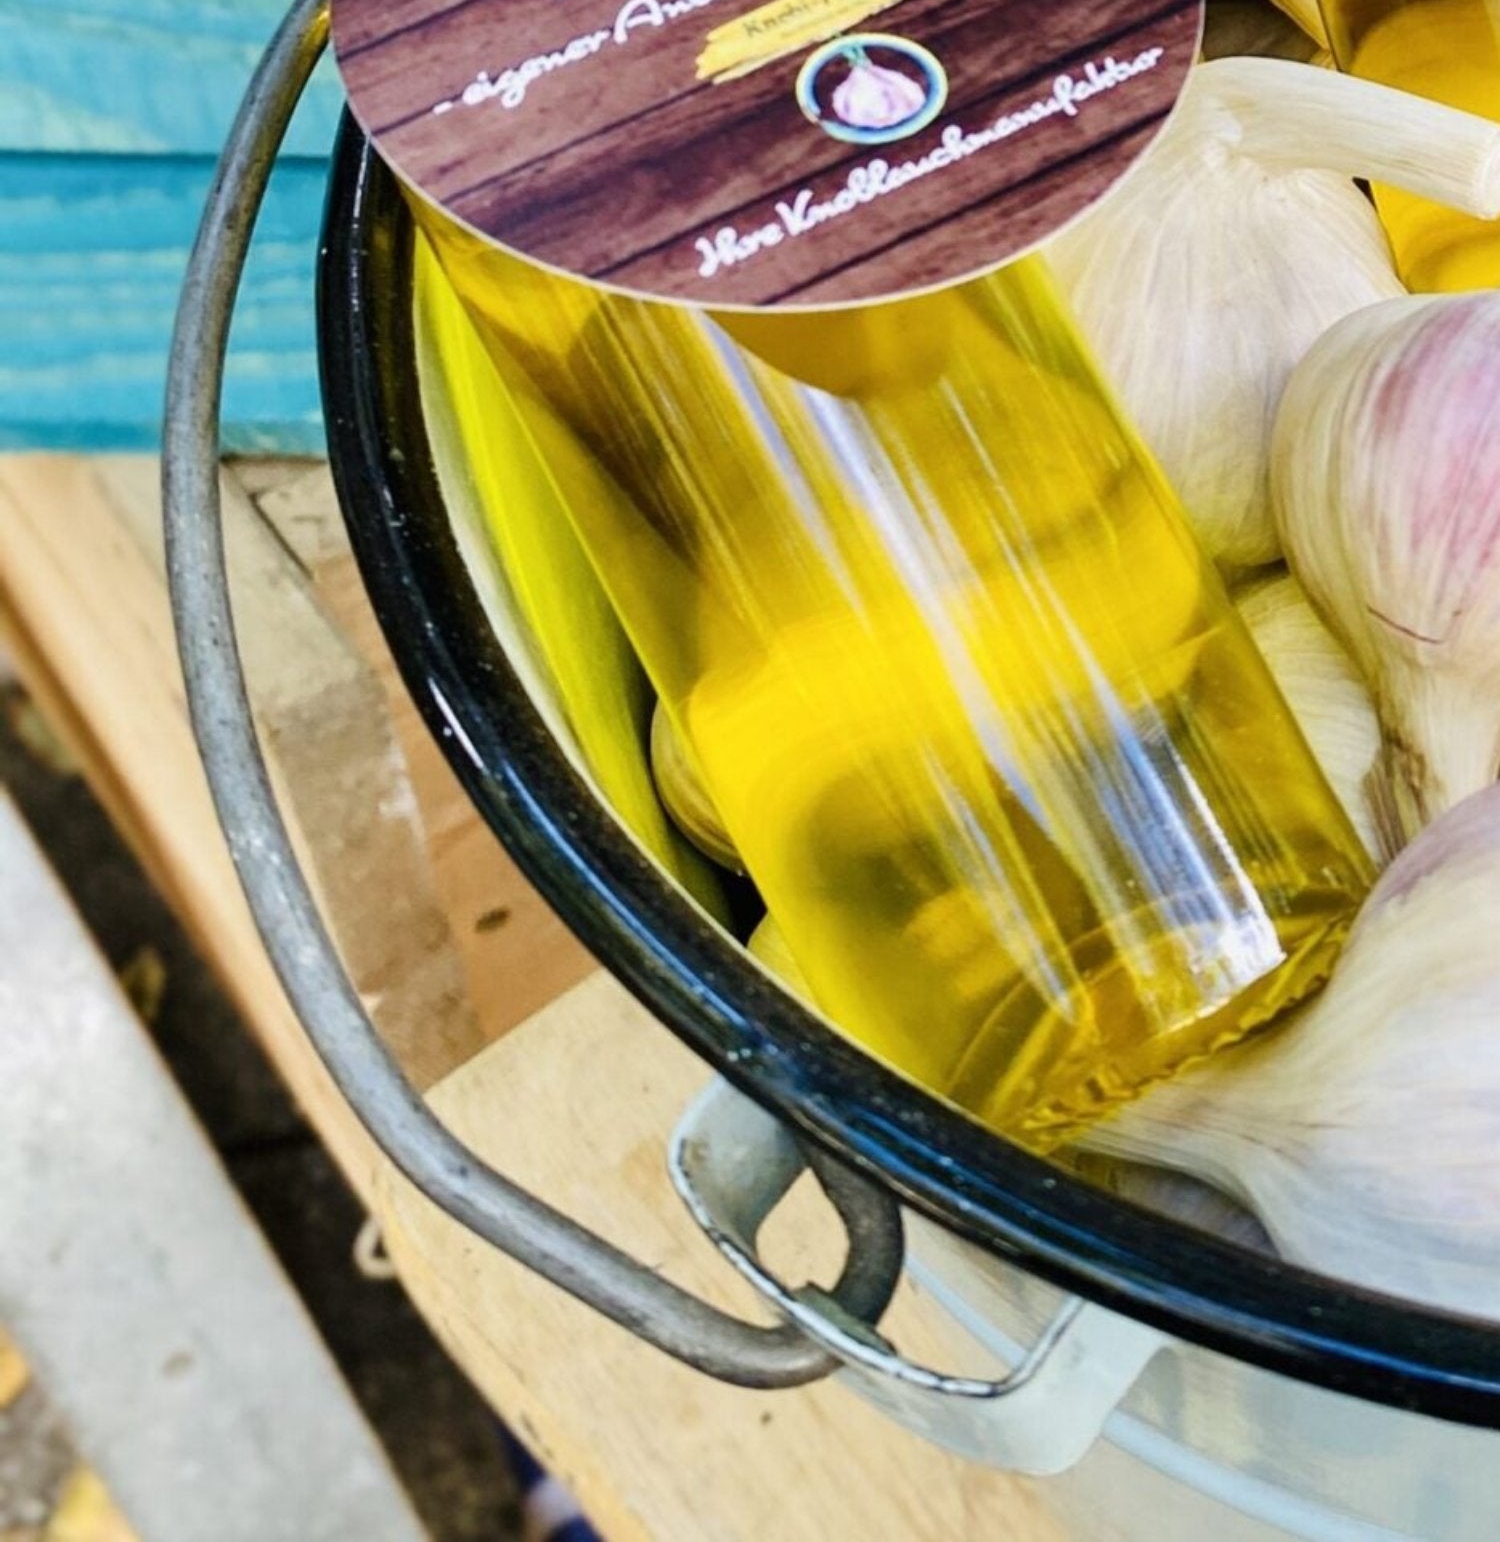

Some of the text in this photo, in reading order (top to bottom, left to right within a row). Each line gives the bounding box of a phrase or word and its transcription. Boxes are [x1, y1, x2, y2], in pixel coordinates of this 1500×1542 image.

[462, 27, 612, 108] eigener
[695, 46, 1164, 278] Ihre Knoblauchmanufaktur
